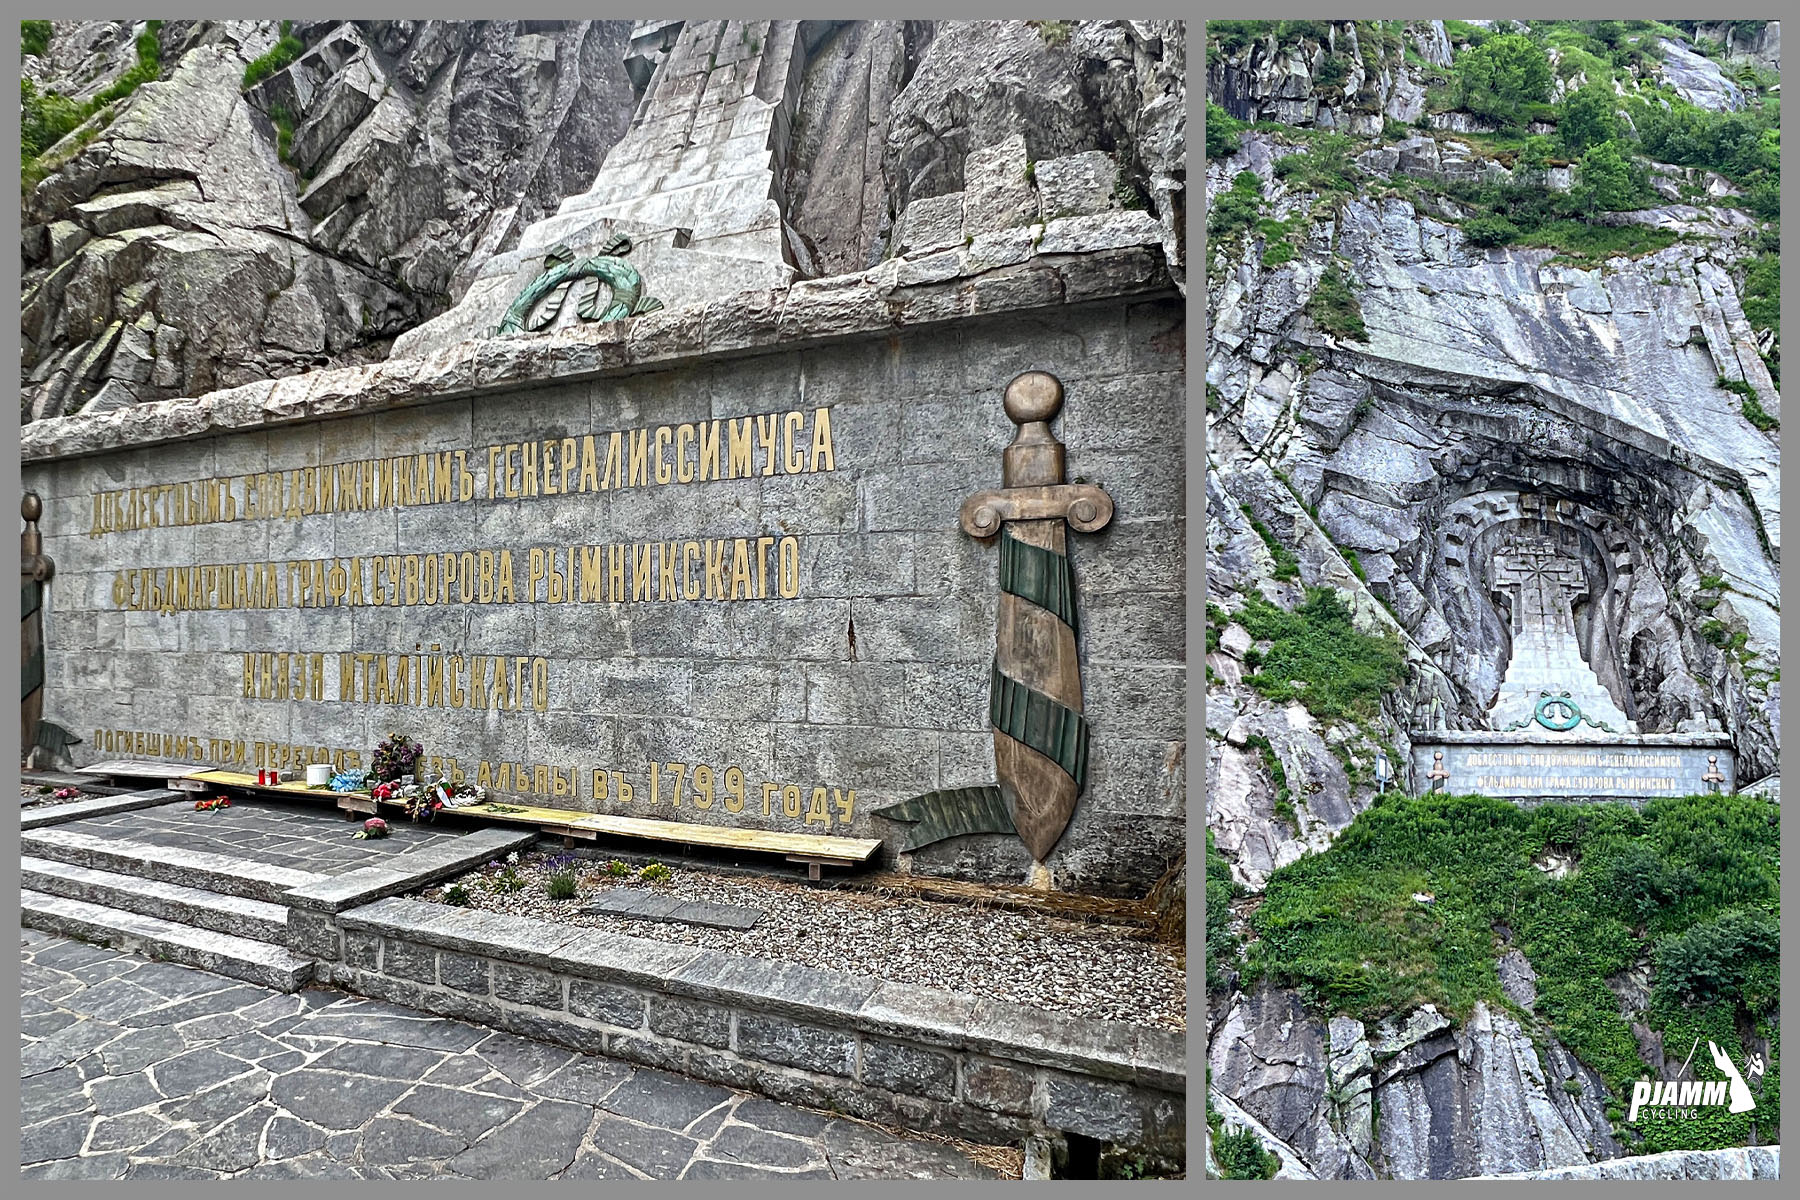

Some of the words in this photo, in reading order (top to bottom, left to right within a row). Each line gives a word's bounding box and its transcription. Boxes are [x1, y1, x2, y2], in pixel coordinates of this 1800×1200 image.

[90, 478, 236, 539] ДОБЛЕСТНЫМЪ
[244, 450, 474, 521] СПОДВИЖНИКАМЪ
[488, 407, 835, 500] ГЕНЕРАЛИССИМУСА
[112, 562, 279, 617] ФЕЛЬДМАРШАЛА
[287, 557, 364, 608] ГРАФА
[372, 549, 515, 606] СУВОРОВА
[528, 536, 799, 603] РЫМНИКСКАГО
[244, 652, 324, 701] КНЯЗЯ
[94, 729, 203, 761] ПОГИБШИМЪ
[208, 739, 246, 765] ПРИ
[476, 760, 578, 797] АЛЬПЫ
[649, 761, 745, 813] 1799
